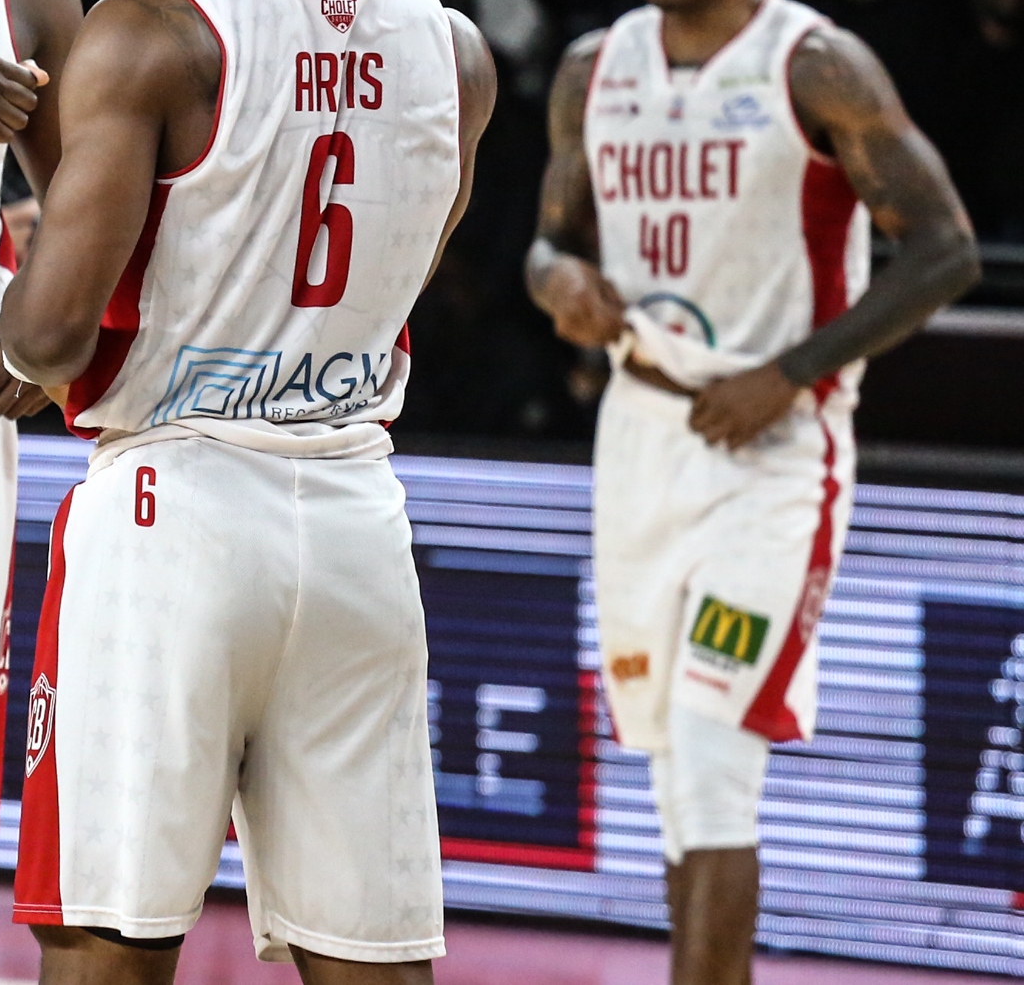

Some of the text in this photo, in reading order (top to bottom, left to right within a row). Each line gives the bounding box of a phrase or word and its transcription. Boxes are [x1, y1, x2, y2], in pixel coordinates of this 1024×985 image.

[295, 50, 384, 113] ARIS
[598, 140, 746, 202] CHOLET
[291, 131, 355, 308] 6
[640, 213, 690, 278] 40
[134, 465, 157, 527] 6
